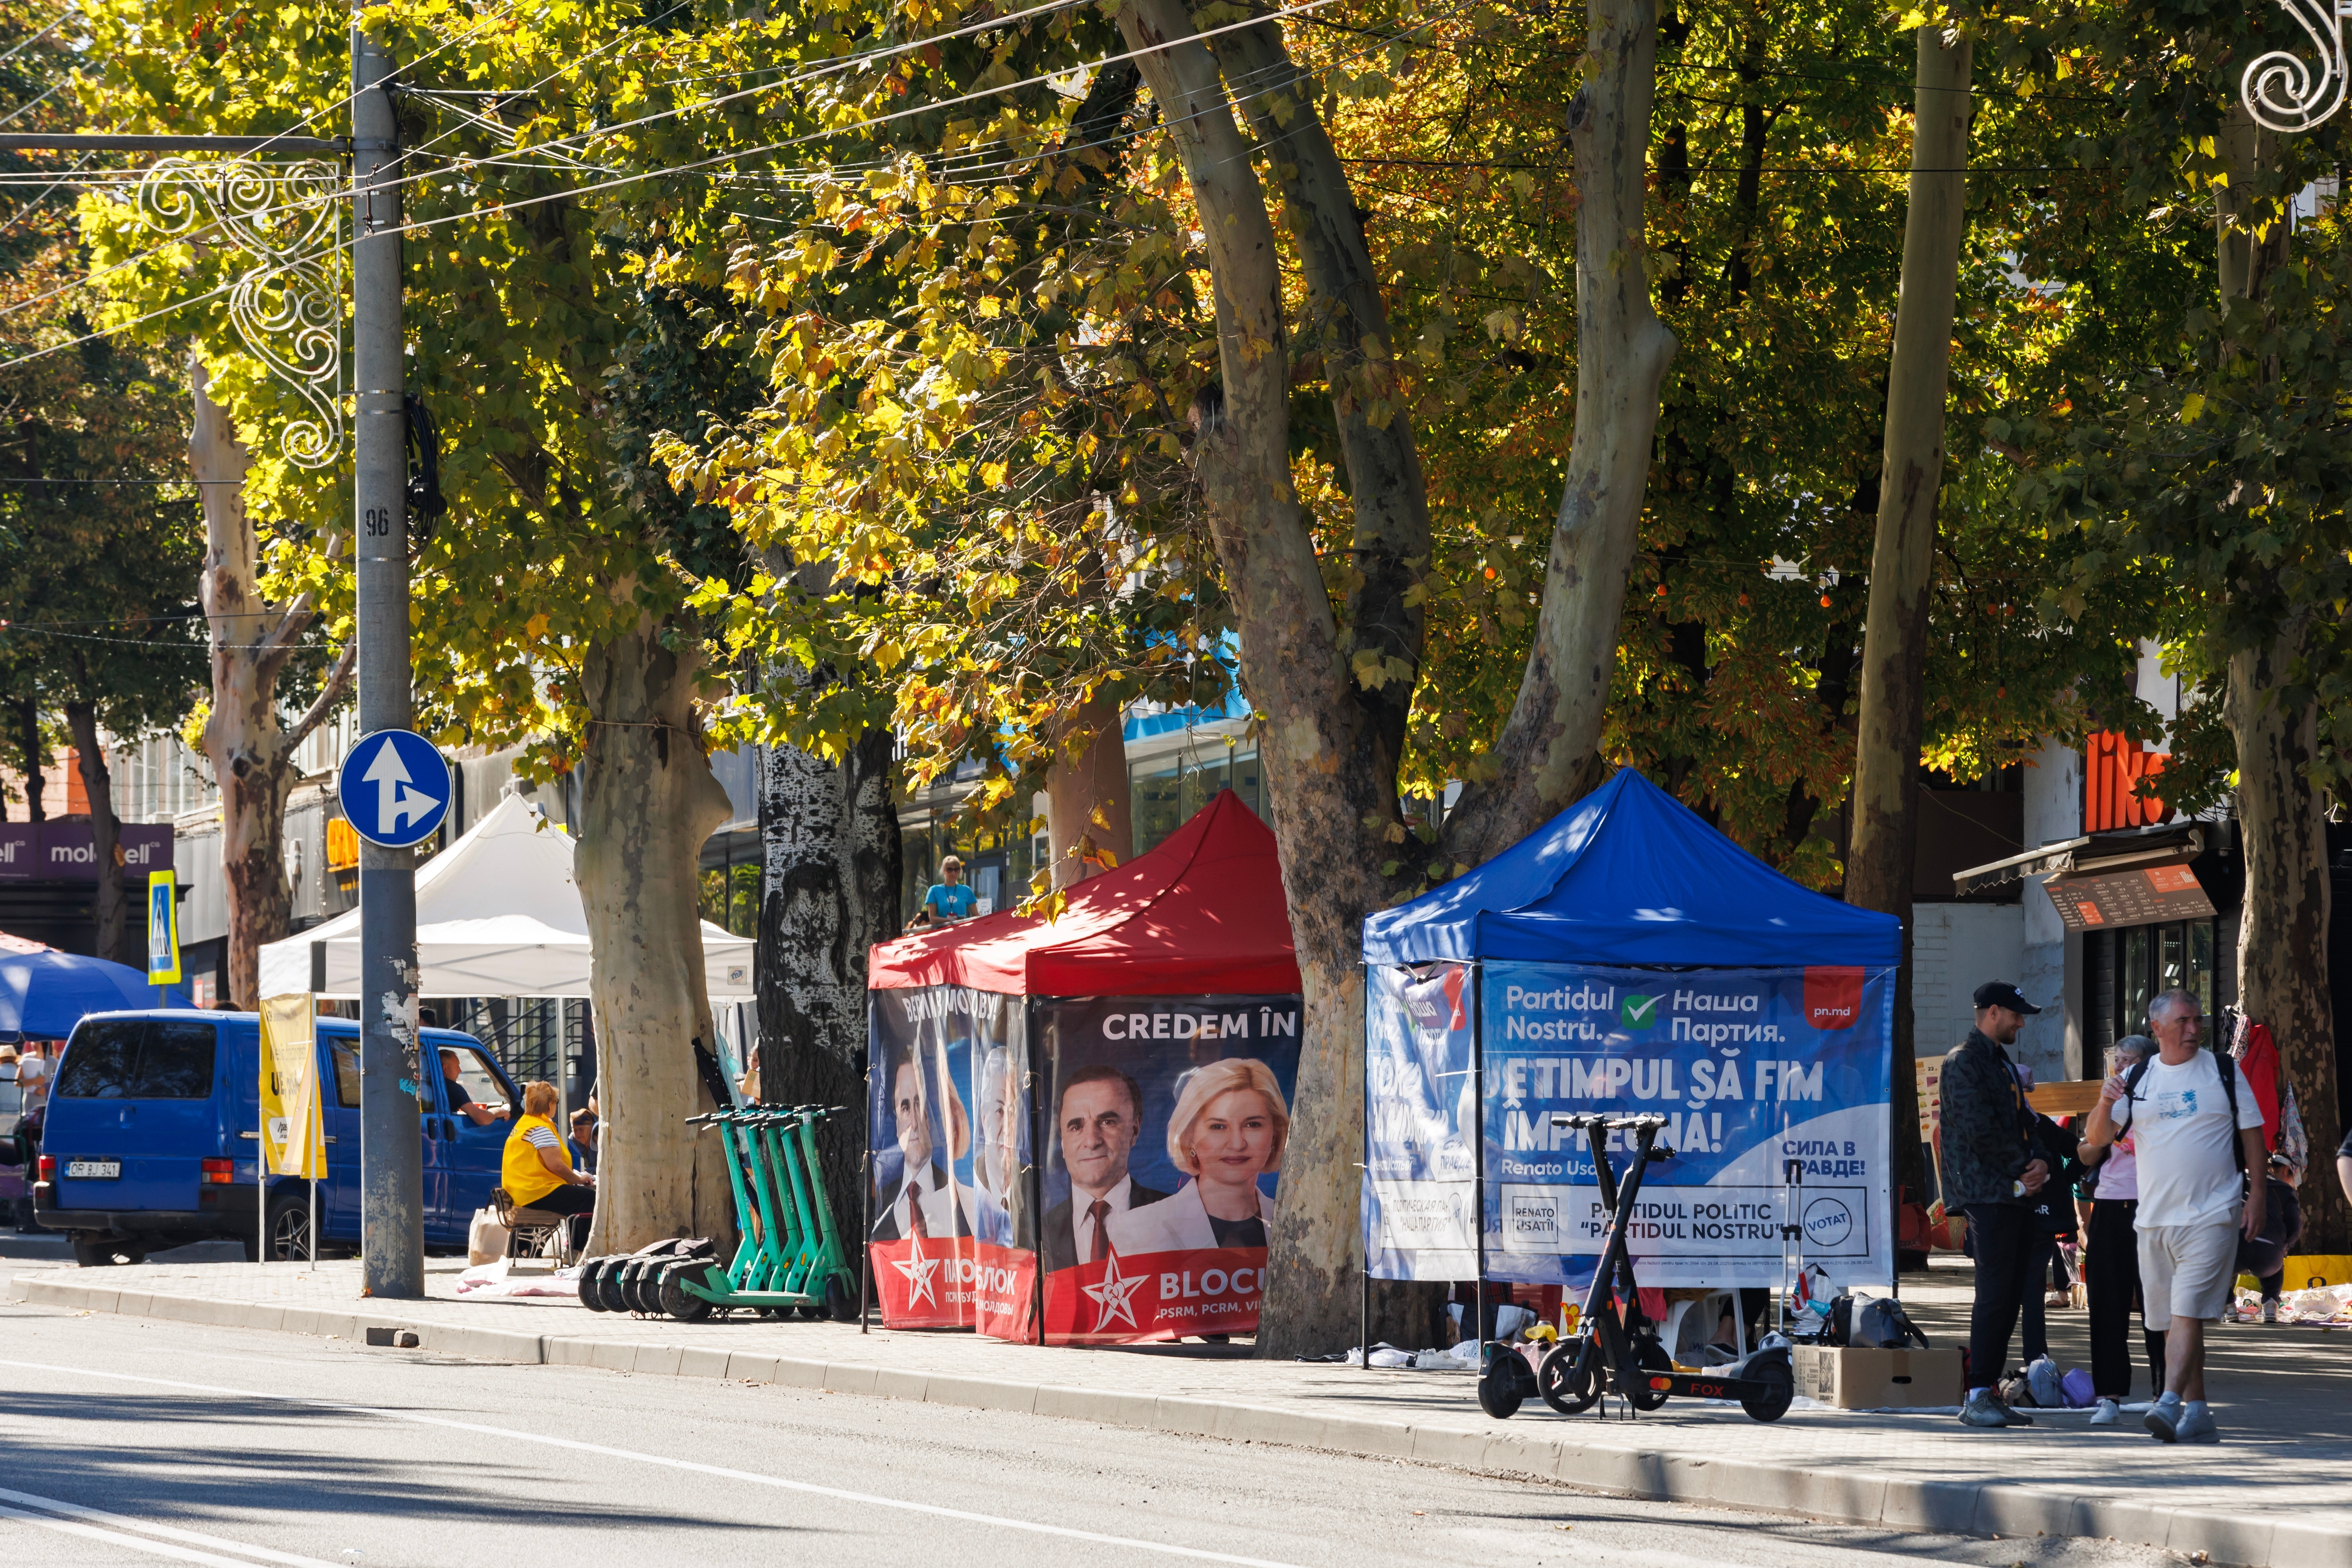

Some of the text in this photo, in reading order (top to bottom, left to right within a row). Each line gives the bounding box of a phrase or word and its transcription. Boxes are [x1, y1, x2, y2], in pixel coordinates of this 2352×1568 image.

[366, 508, 389, 537] 96
[51, 843, 150, 864] molell
[1507, 986, 1614, 1010] Partidul
[1673, 989, 1758, 1012] Наша
[1814, 1006, 1850, 1018] pn.md
[1103, 1006, 1296, 1040] CREDEM ÎN
[1507, 1016, 1603, 1040] Nostru.
[1672, 1017, 1785, 1047] Партия.
[1536, 1058, 1680, 1099] TIMPUL
[1690, 1047, 1744, 1100] SĂ
[1755, 1060, 1823, 1101] FIM
[1782, 1140, 1856, 1156] СИЛА В
[71, 1164, 84, 1175] OR
[102, 1164, 115, 1176] 341
[1502, 1159, 1613, 1176] Renato Usai
[1516, 1207, 1555, 1218] RENATO
[1592, 1202, 1772, 1219] PTIDUL POLITIC
[1516, 1218, 1553, 1231] USATÎI
[1581, 1221, 1687, 1239] “PATIDUL
[1807, 1213, 1847, 1231] VOTAT
[976, 1265, 1017, 1296] БЛОК
[1160, 1305, 1198, 1319] PSRM,
[1202, 1302, 1242, 1315] PCRM,
[1690, 1383, 1724, 1397] FOX
